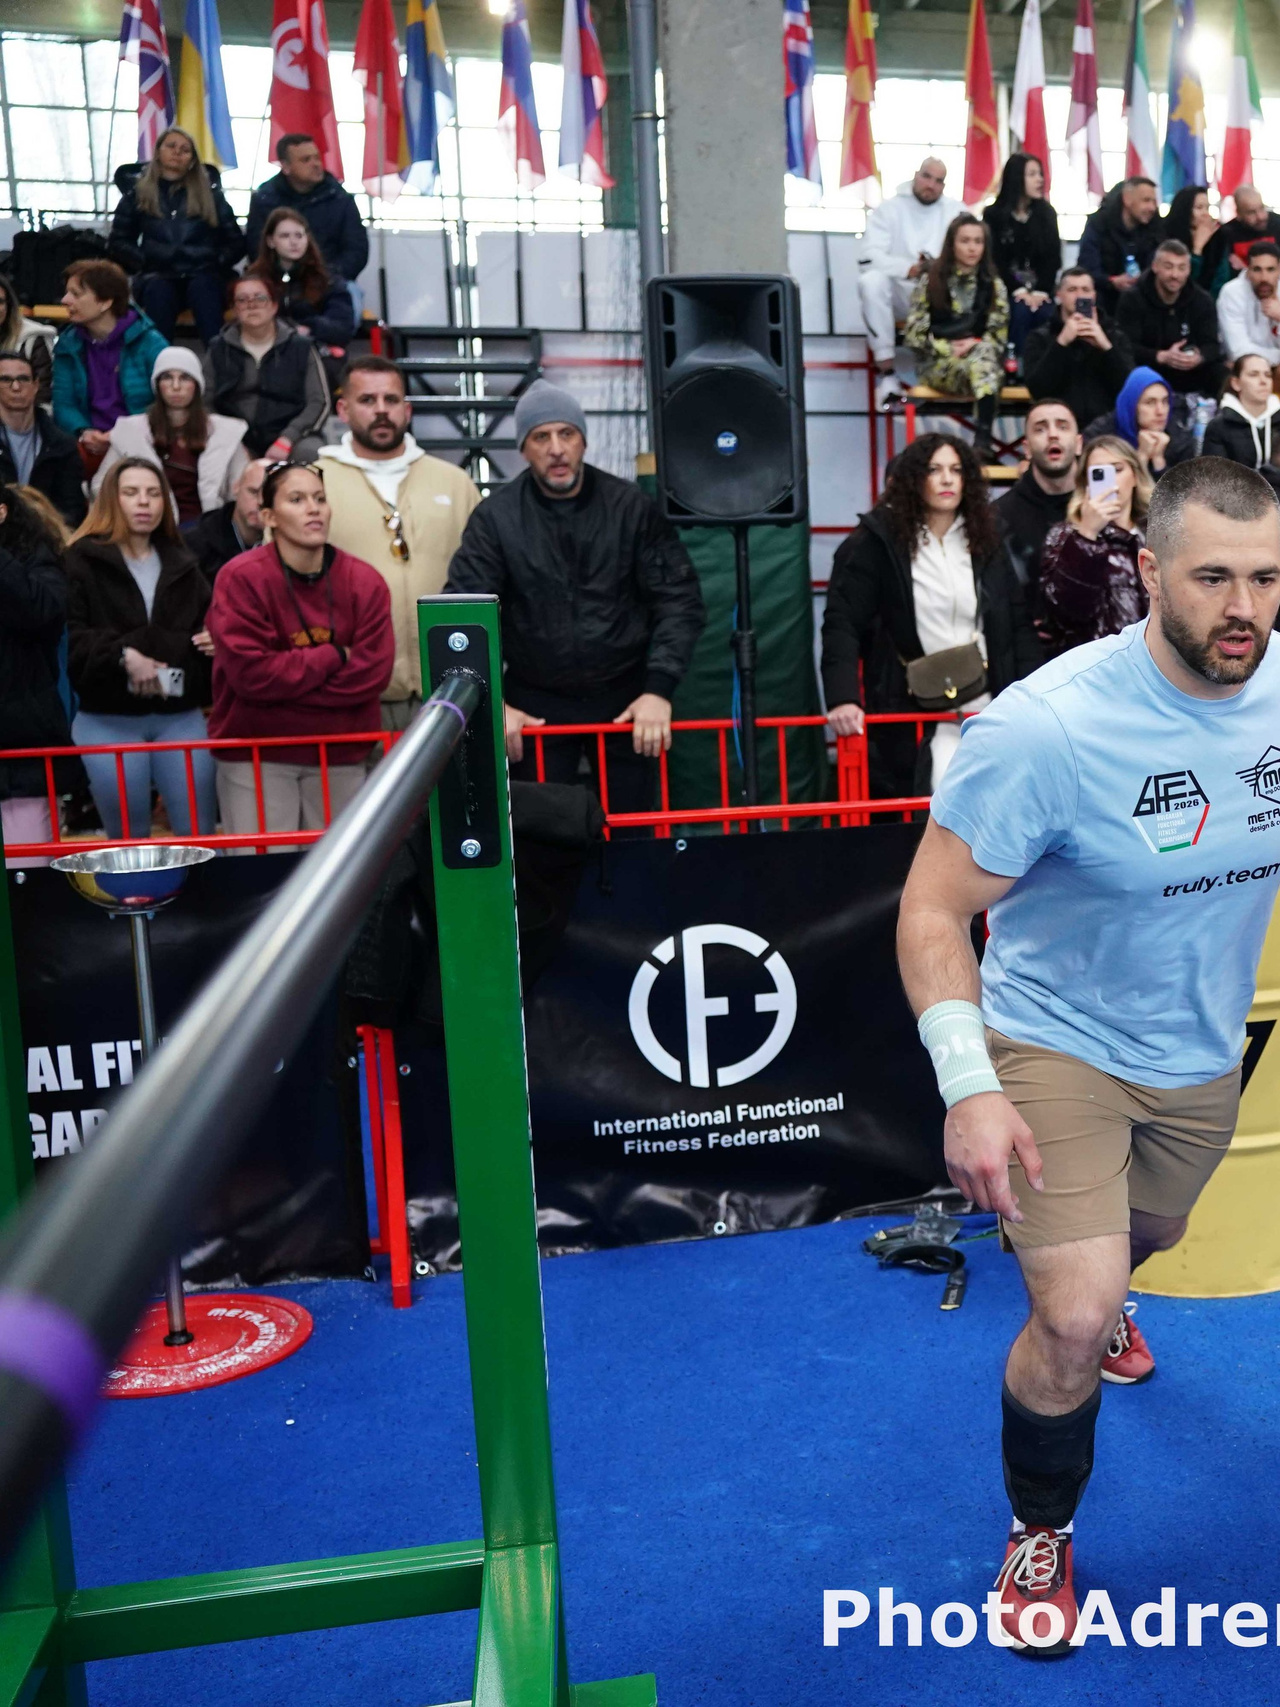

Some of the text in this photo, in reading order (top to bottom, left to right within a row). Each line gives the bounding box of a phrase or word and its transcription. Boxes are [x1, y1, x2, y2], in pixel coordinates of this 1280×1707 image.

[1173, 799, 1200, 811] 2026
[1156, 811, 1183, 822] BULGARIAN
[1157, 818, 1186, 829] FUNCTIONAL
[1249, 821, 1270, 833] design
[1270, 820, 1276, 828] &
[1158, 828, 1178, 837] FITNESS
[27, 1044, 84, 1093] AL
[593, 1092, 844, 1137] International Functional
[623, 1122, 820, 1155] Fitness Federation
